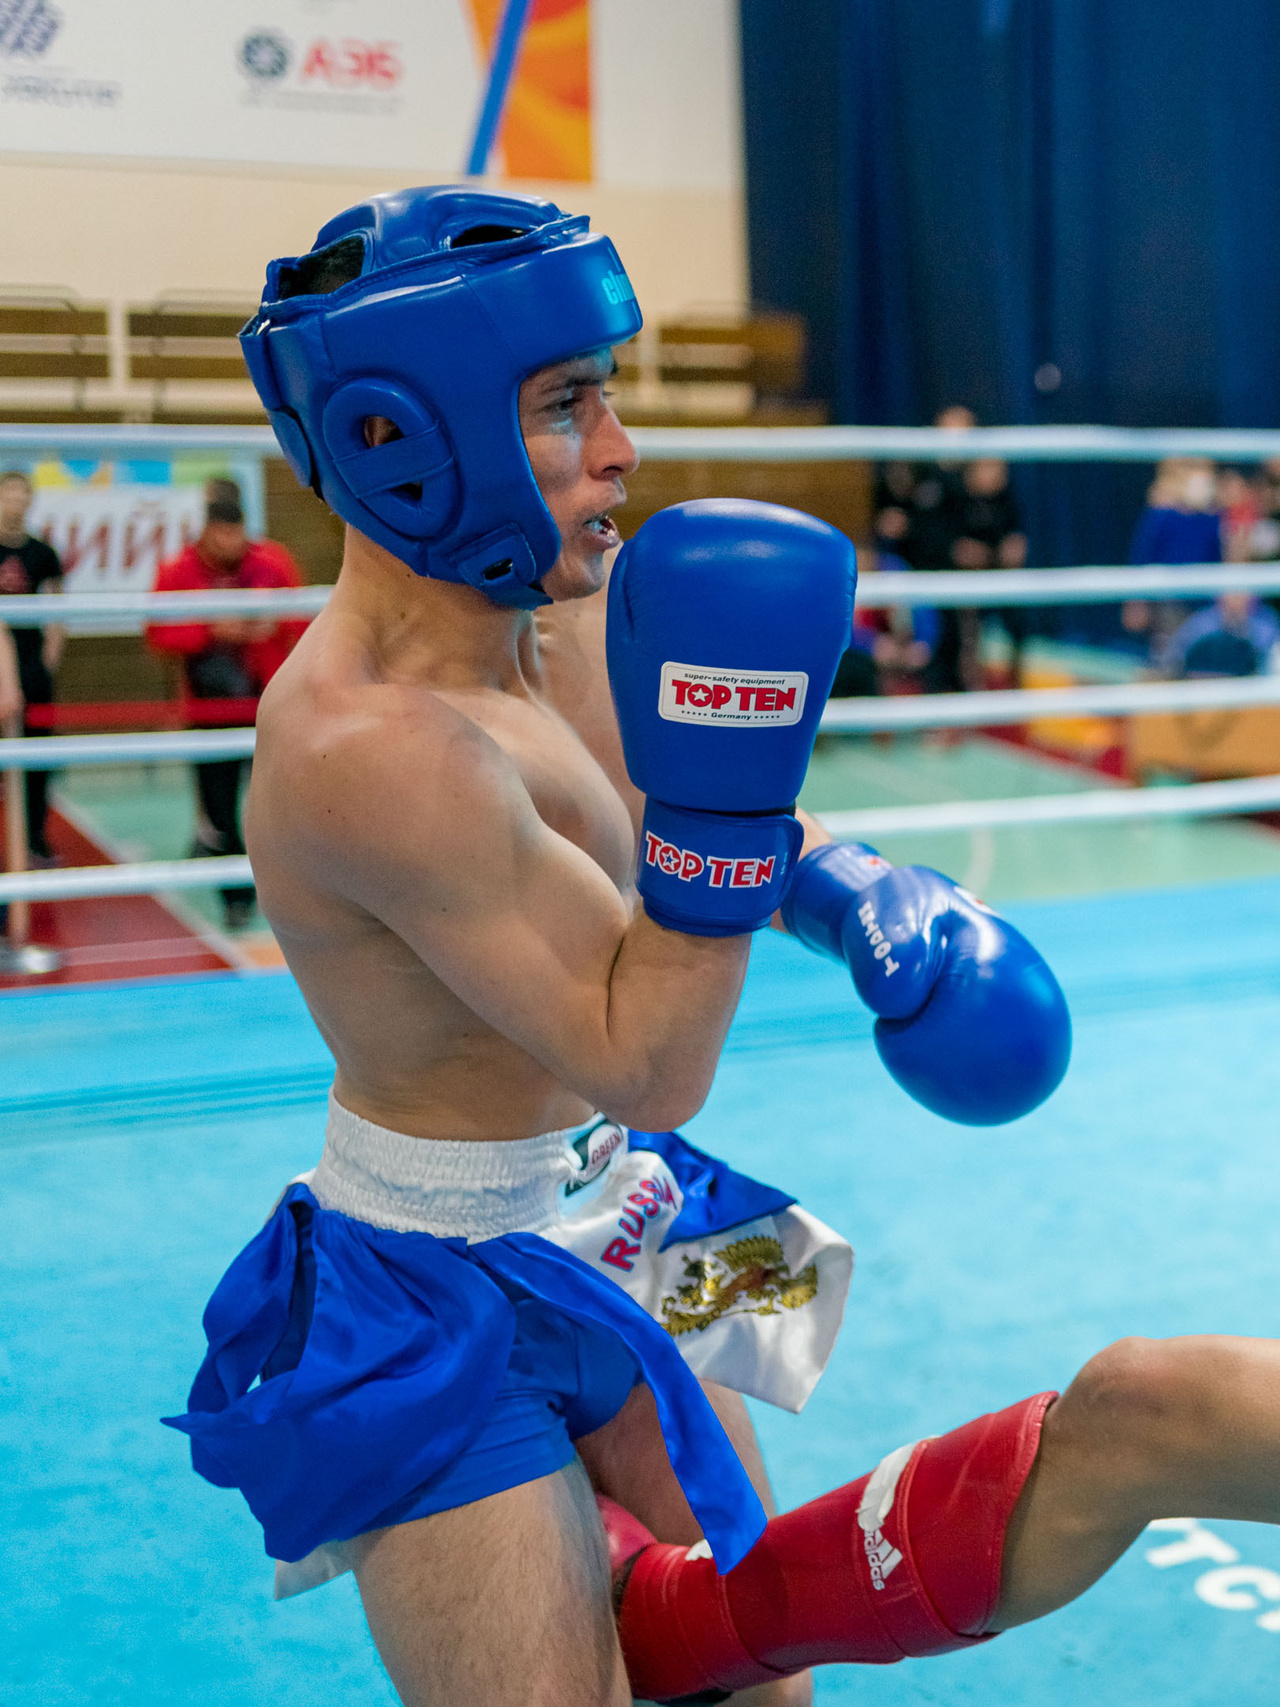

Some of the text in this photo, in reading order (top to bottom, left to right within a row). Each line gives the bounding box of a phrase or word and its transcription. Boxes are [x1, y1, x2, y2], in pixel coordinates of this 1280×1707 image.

[684, 672, 786, 686] super-safety equipment
[672, 679, 797, 711] TOP TEN
[711, 712, 753, 721] Germany
[646, 830, 704, 882] TOP
[706, 855, 777, 888] TEN
